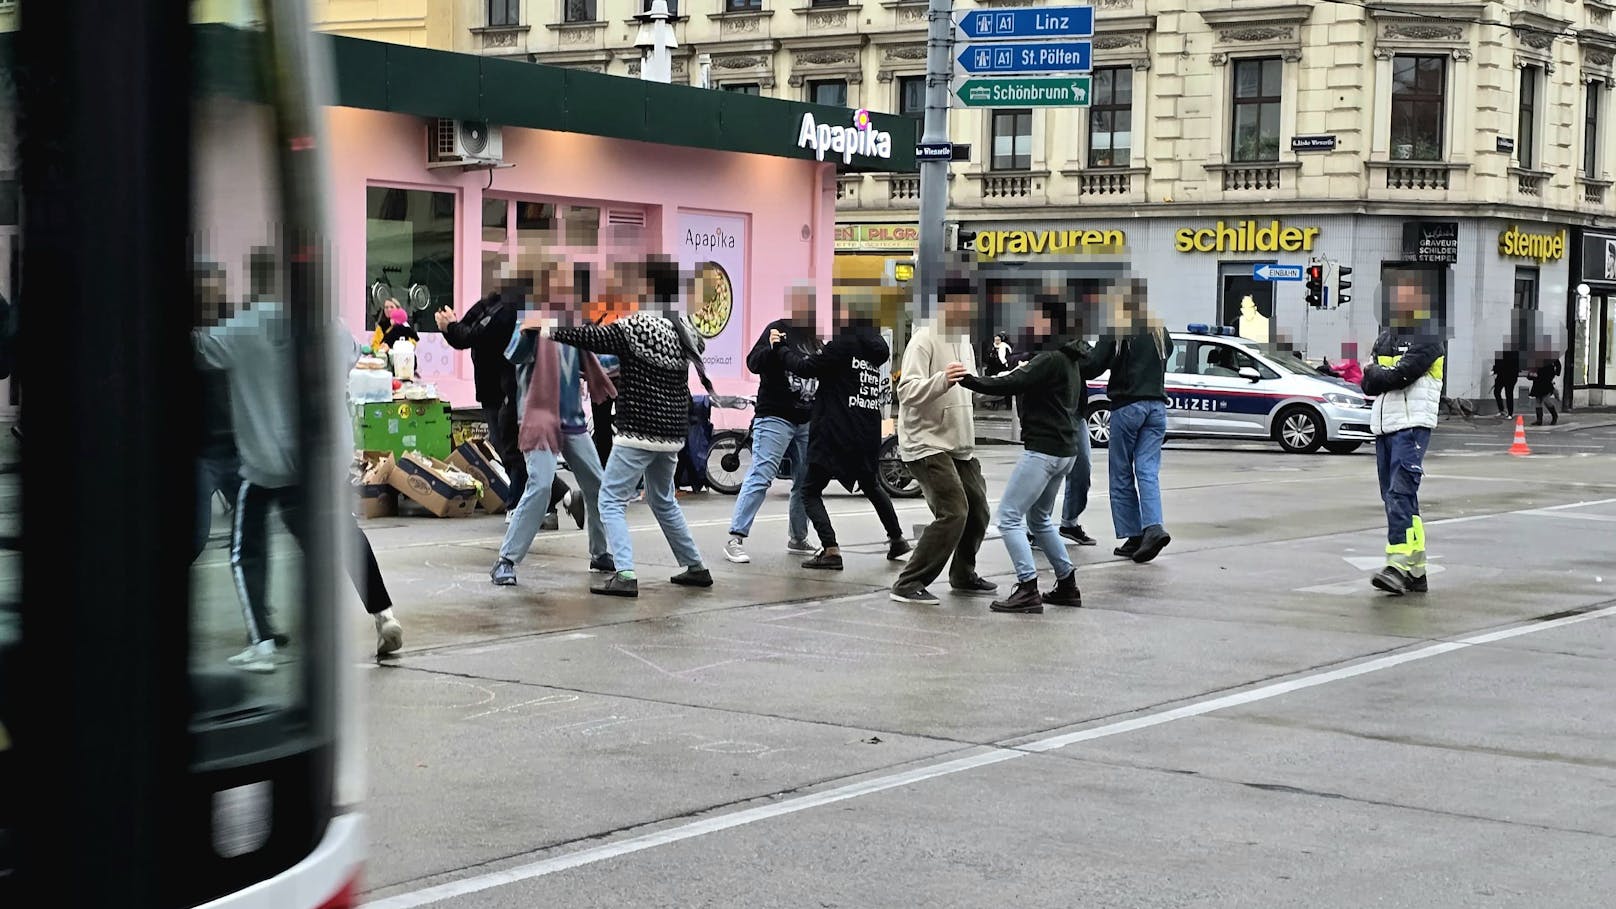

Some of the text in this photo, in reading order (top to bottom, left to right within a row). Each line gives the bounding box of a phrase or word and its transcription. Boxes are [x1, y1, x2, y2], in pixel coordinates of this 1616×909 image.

[1000, 14, 1070, 30] A1 Linz
[998, 48, 1080, 65] A1 St. Pölten
[993, 84, 1069, 101] Schönbrunn
[798, 111, 892, 164] Apapika
[685, 228, 735, 252] Apapika
[868, 227, 919, 241] PILGR
[1175, 220, 1319, 253] schilder
[976, 229, 1124, 258] gravuren
[1419, 239, 1457, 247] GRAVEUR
[1504, 225, 1566, 264] stempel
[1419, 254, 1457, 262] STEMPEL
[1270, 269, 1298, 277] EINBAHN
[859, 369, 879, 386] there
[860, 382, 869, 395] is
